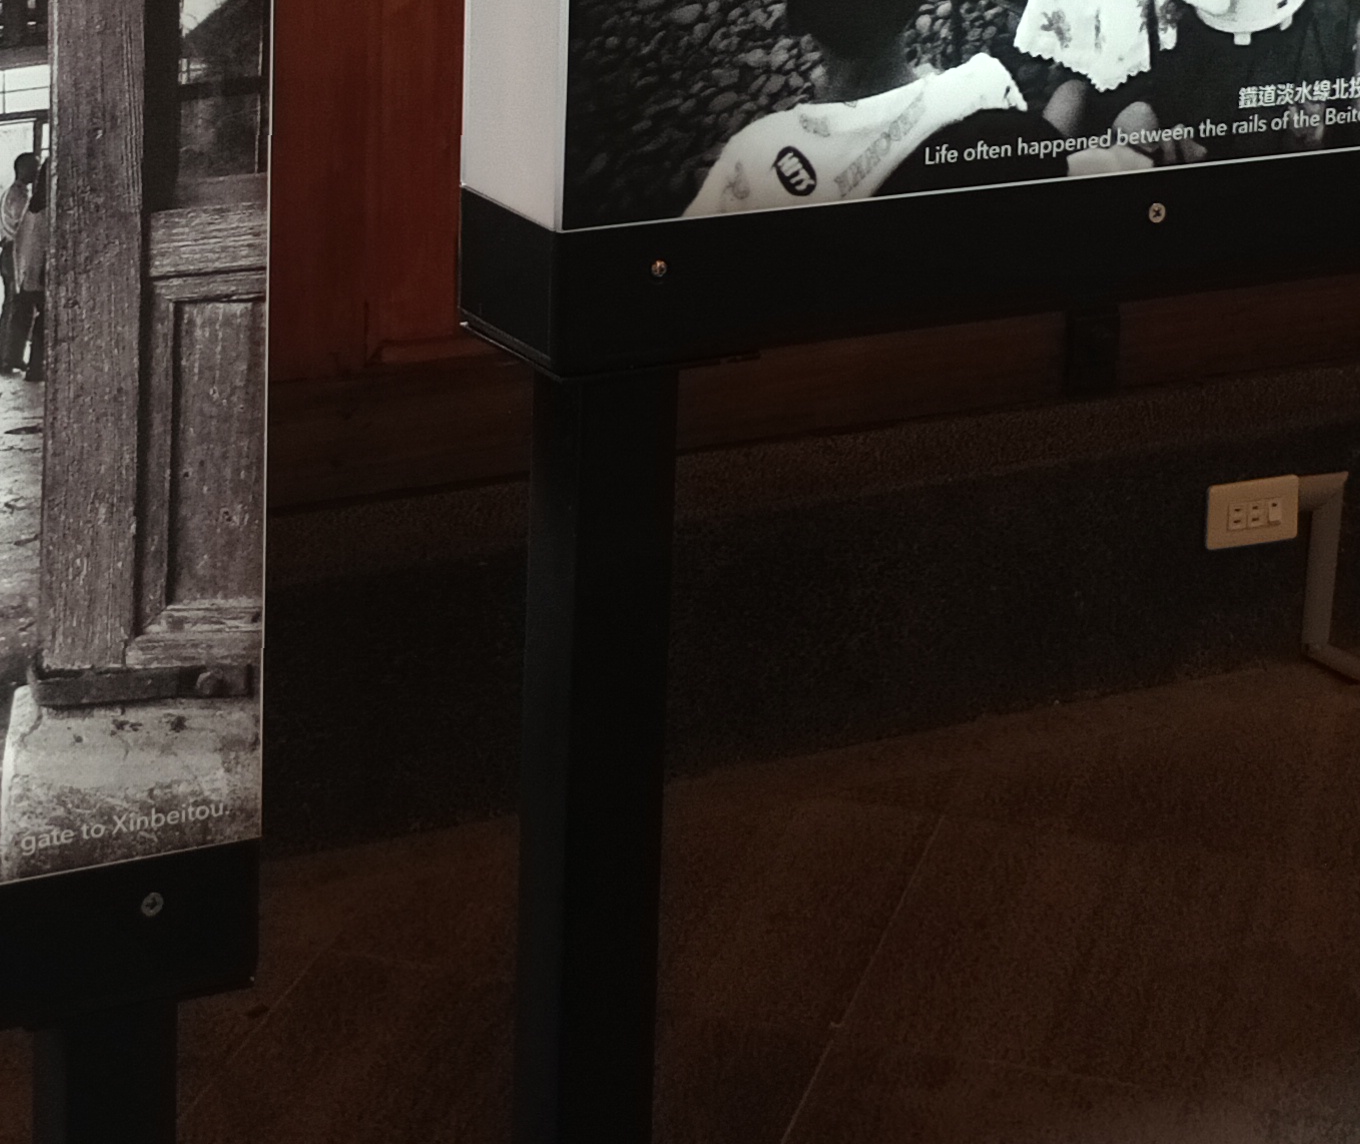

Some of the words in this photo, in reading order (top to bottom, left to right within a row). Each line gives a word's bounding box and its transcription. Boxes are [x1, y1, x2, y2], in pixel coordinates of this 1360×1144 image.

[925, 143, 959, 166] Life
[963, 139, 1012, 162] often
[1017, 127, 1112, 160] happened
[1116, 124, 1194, 147] between
[1199, 118, 1226, 138] the
[1232, 113, 1267, 135] rails
[1270, 112, 1291, 132] of
[1293, 109, 1321, 129] the
[20, 826, 75, 856] gate
[82, 822, 107, 841] to
[112, 802, 231, 837] Xinbeitou.
